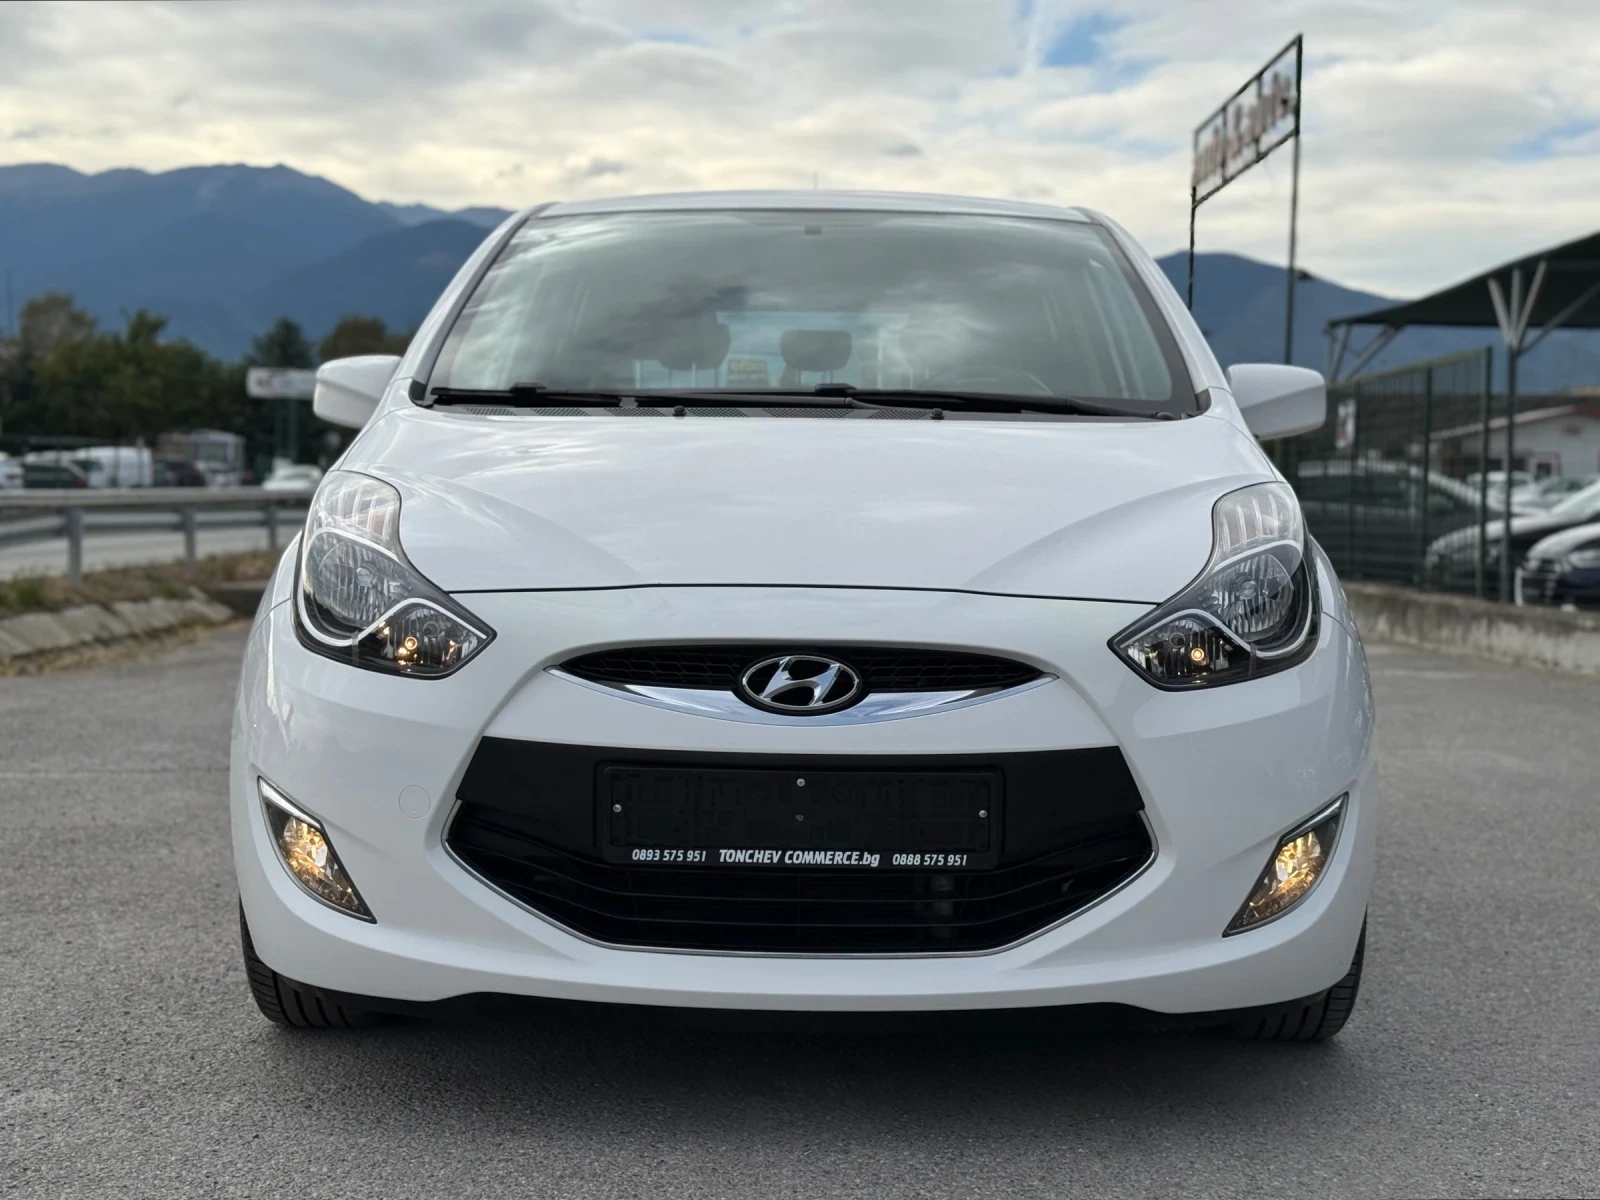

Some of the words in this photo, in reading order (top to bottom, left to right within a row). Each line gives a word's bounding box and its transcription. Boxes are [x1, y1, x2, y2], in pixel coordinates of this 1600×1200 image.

[632, 849, 661, 861] 0893
[662, 849, 685, 862] 575
[687, 849, 707, 862] 951
[718, 849, 783, 864] TONCHEV
[784, 850, 881, 868] COMMERCE.bg
[892, 853, 922, 866] 0888
[924, 853, 945, 866] 575
[946, 854, 968, 867] 951
